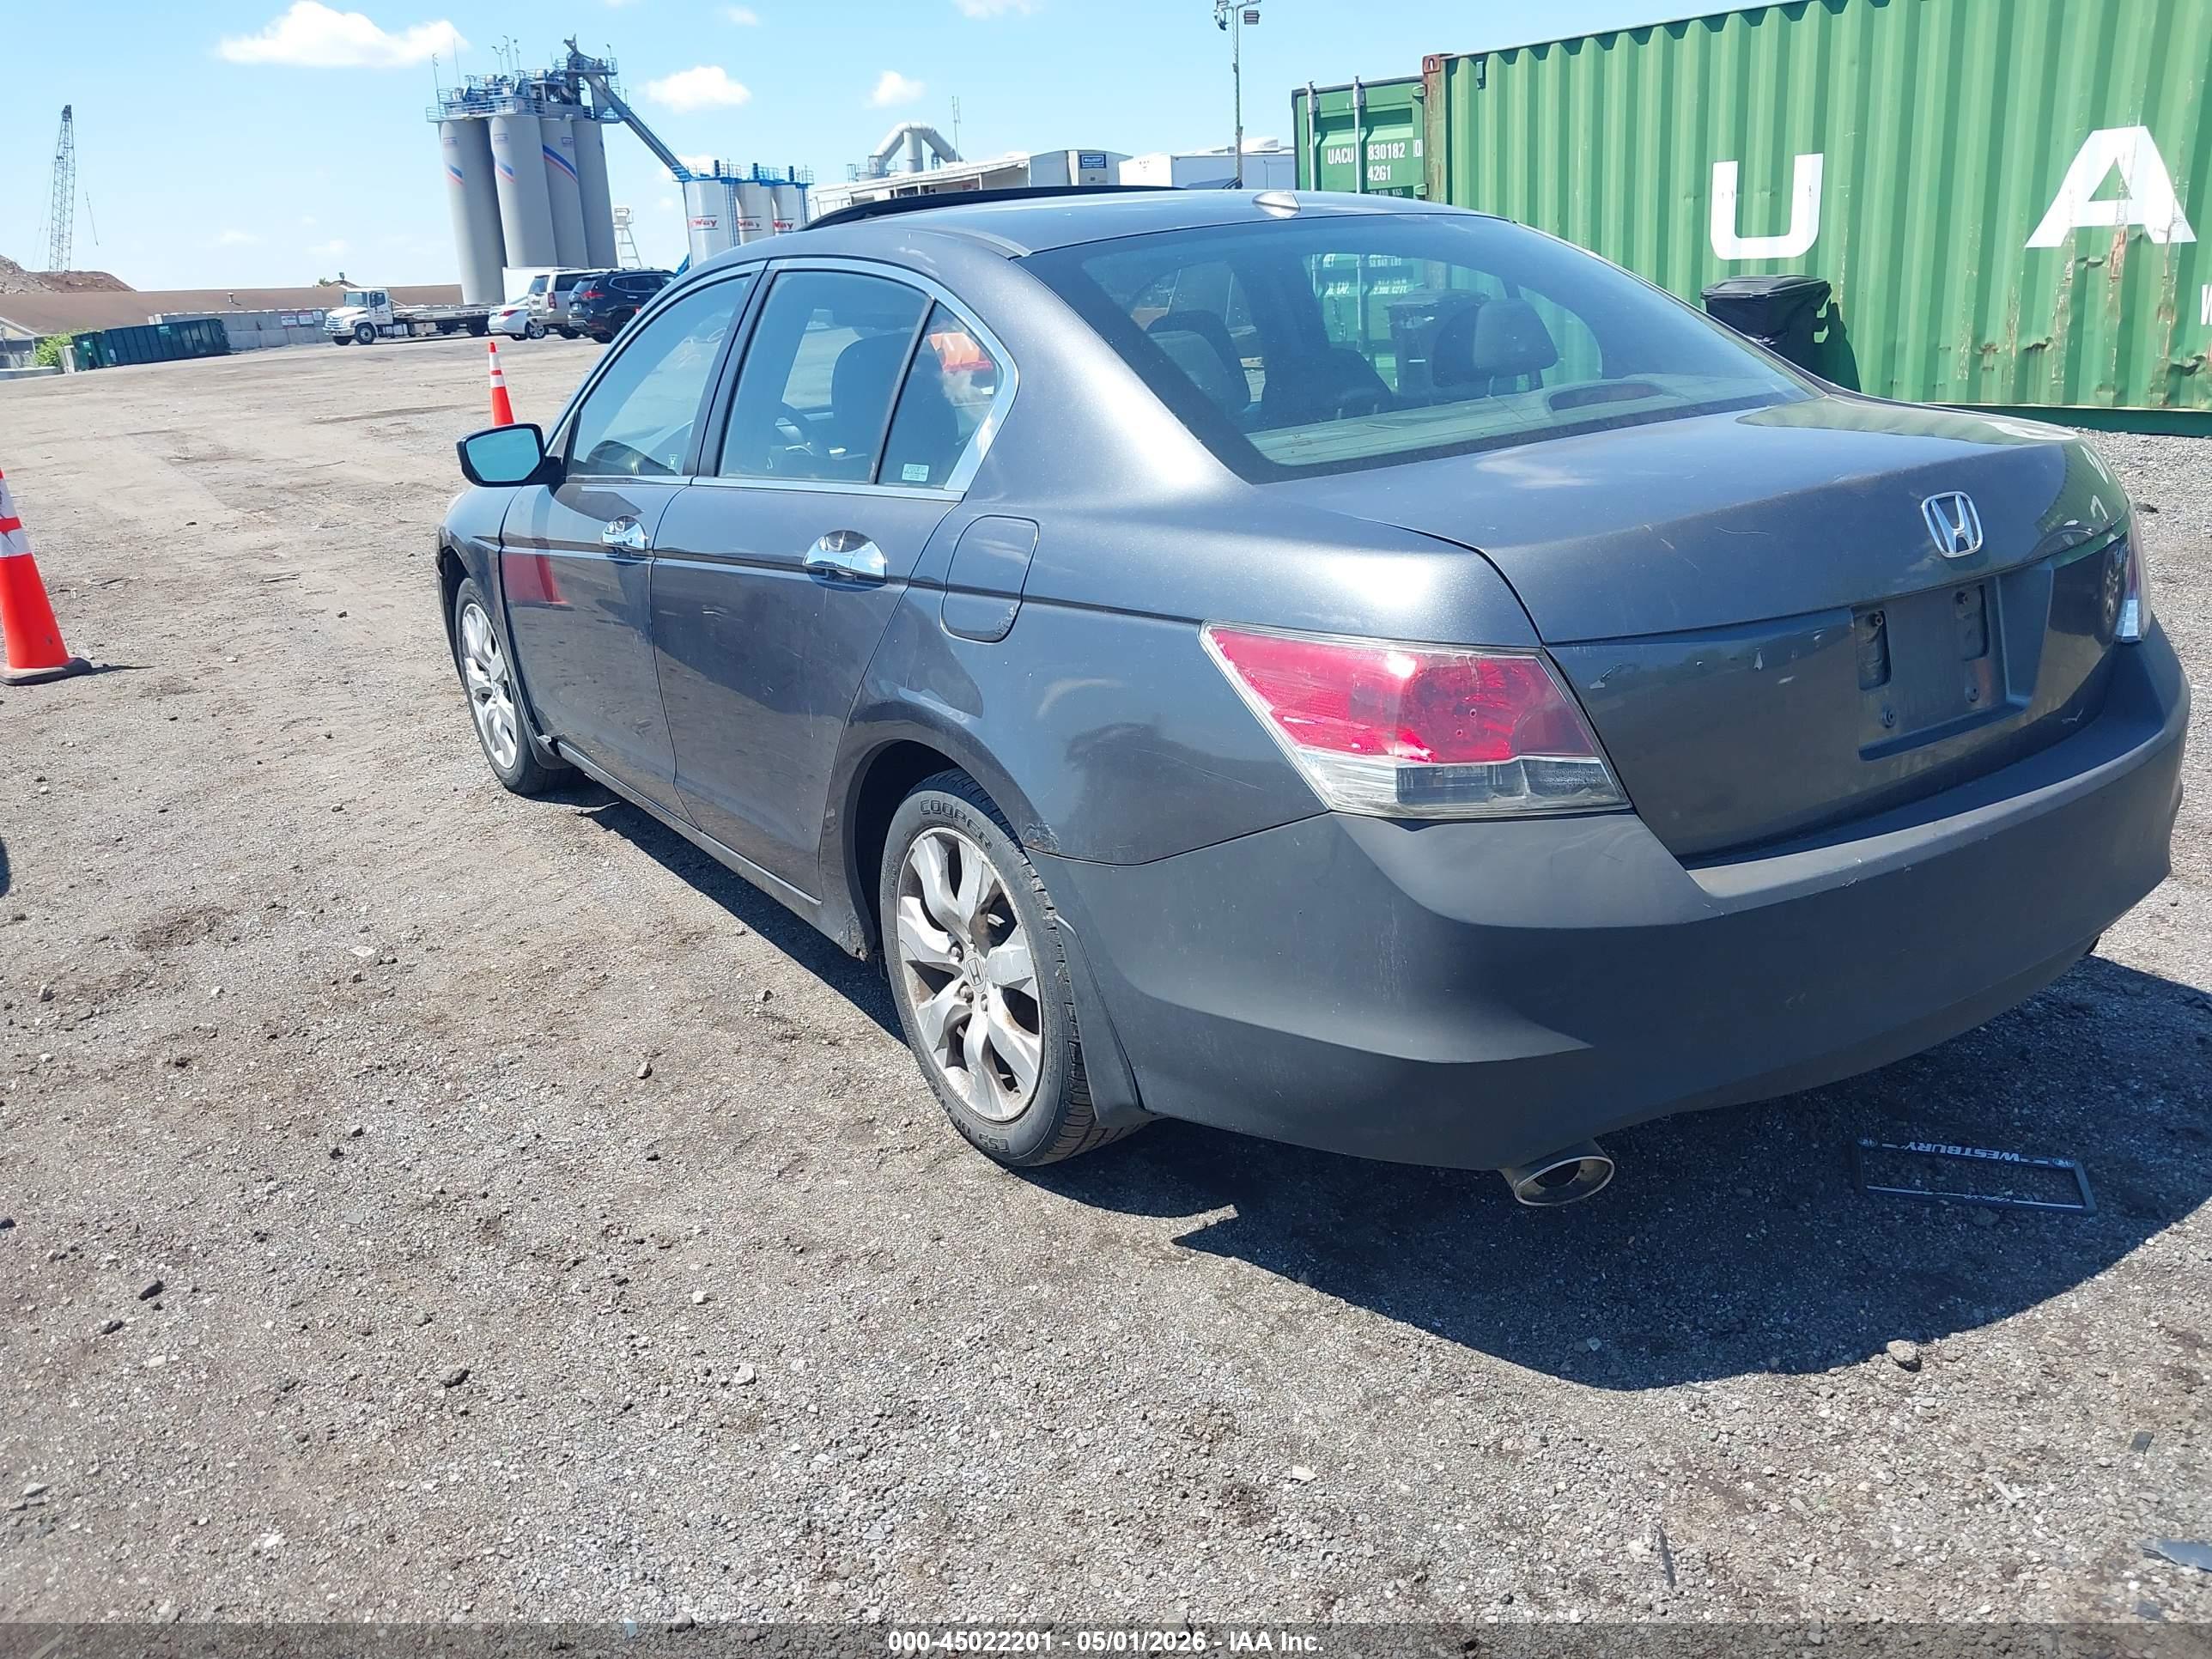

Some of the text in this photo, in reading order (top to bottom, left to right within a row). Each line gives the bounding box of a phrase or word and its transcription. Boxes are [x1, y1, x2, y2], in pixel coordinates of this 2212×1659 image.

[1328, 147, 1354, 164] UACU
[1367, 143, 1405, 161] 830182
[1367, 165, 1391, 181] 42G1
[921, 799, 993, 849] COOPER
[1904, 1141, 2021, 1162] WESTBURY
